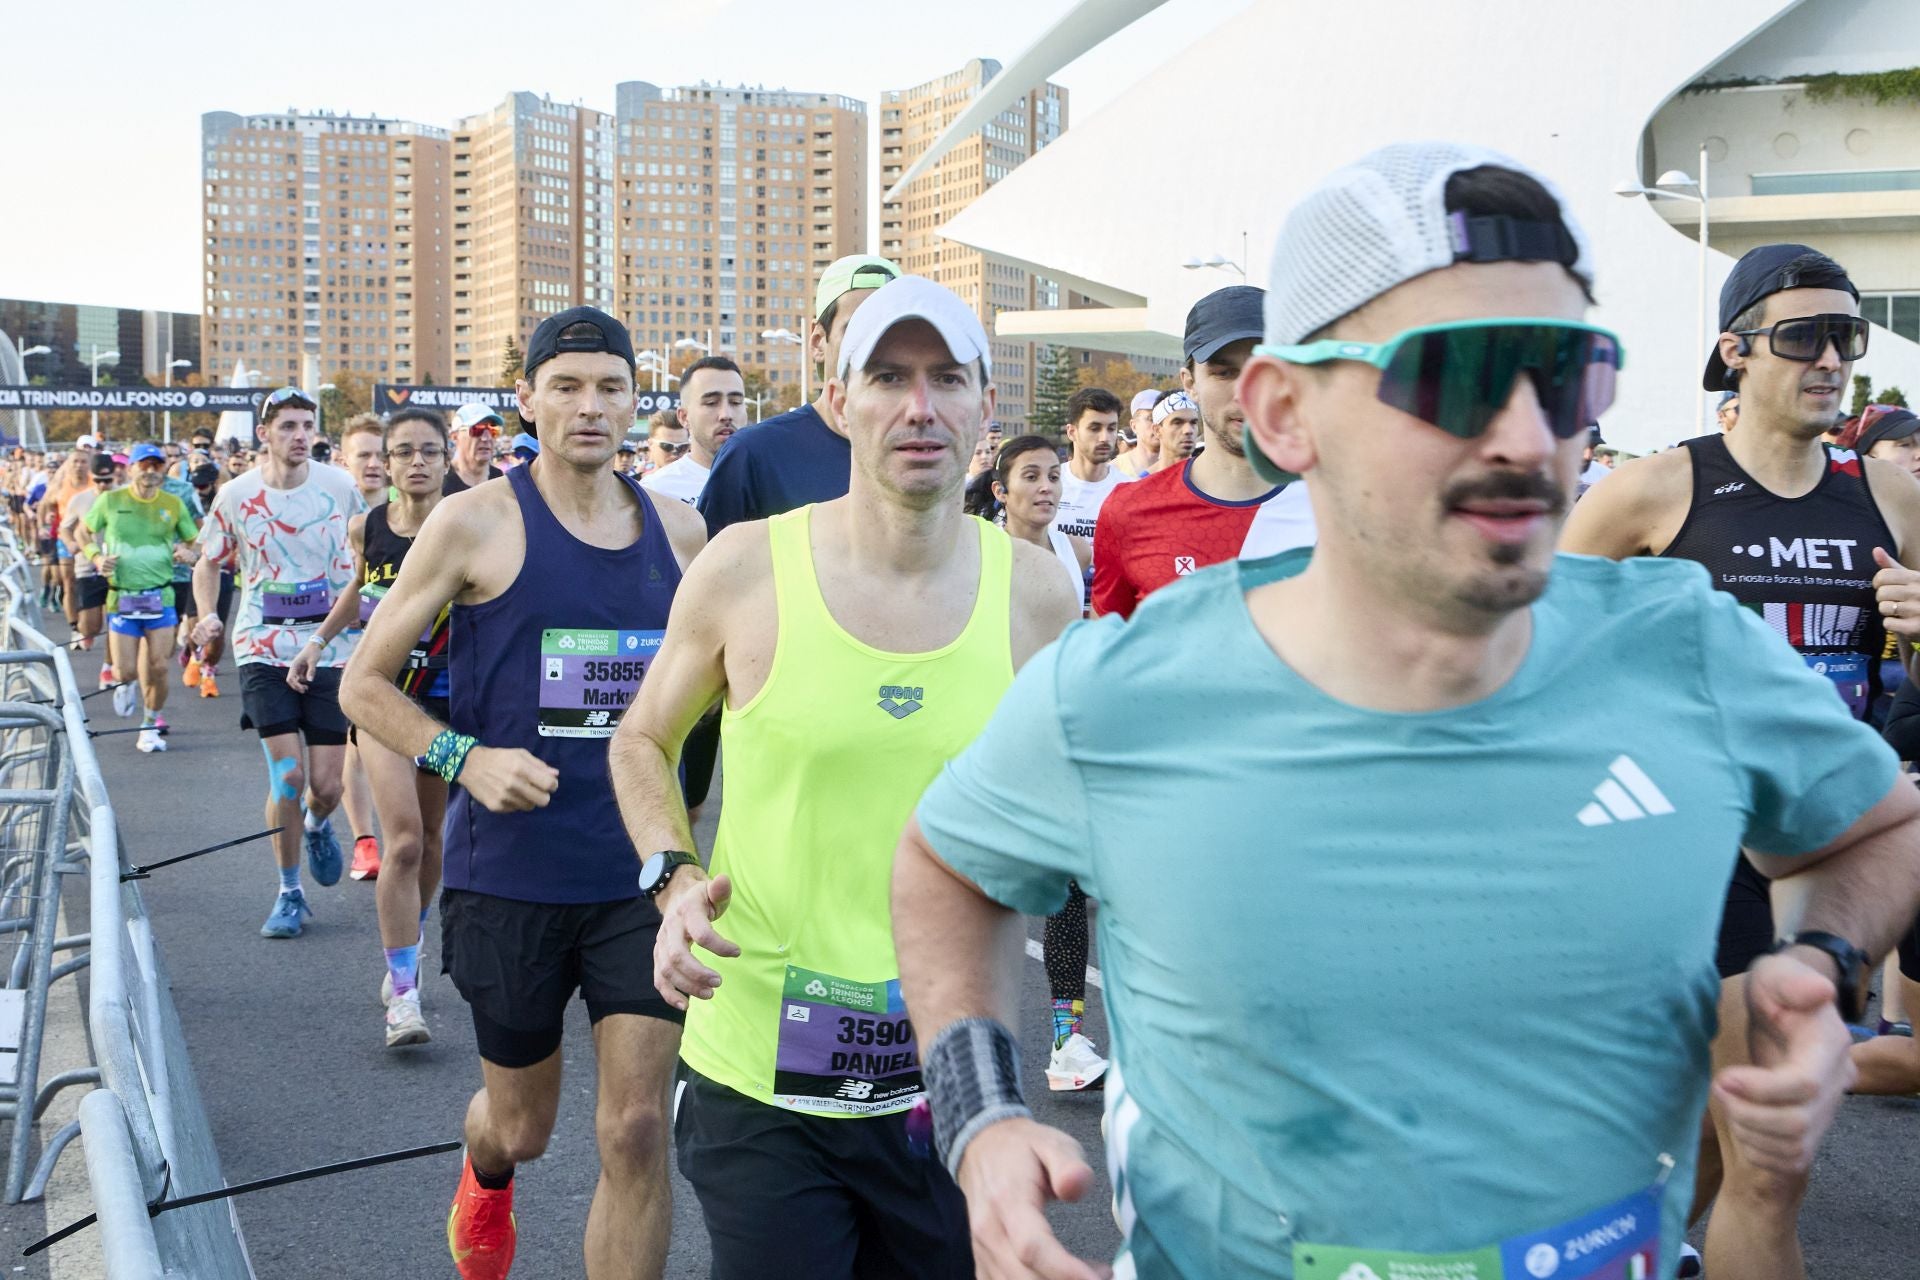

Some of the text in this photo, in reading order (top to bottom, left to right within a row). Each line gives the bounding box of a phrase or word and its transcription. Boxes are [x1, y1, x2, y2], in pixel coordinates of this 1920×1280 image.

[21, 390, 104, 406] TRINIDAD
[104, 391, 187, 407] ALFONSO
[208, 394, 249, 405] ZURICH
[409, 391, 436, 405] 42K
[438, 391, 499, 407] VALENCIA
[1769, 536, 1857, 571] MET
[1722, 573, 1737, 583] La
[1738, 574, 1773, 583] nostra
[281, 595, 311, 606] 11437
[577, 638, 609, 646] TRINIDAD
[583, 661, 645, 682] 35855
[879, 686, 924, 700] arena
[830, 987, 874, 1001] TRINIDAD
[830, 995, 874, 1007] ALFONSO
[836, 1016, 915, 1046] 3590
[831, 1051, 918, 1075] DANIEL
[890, 1084, 920, 1096] balance
[843, 1103, 881, 1113] TRINIDAD
[1564, 1213, 1637, 1261] ZURICH
